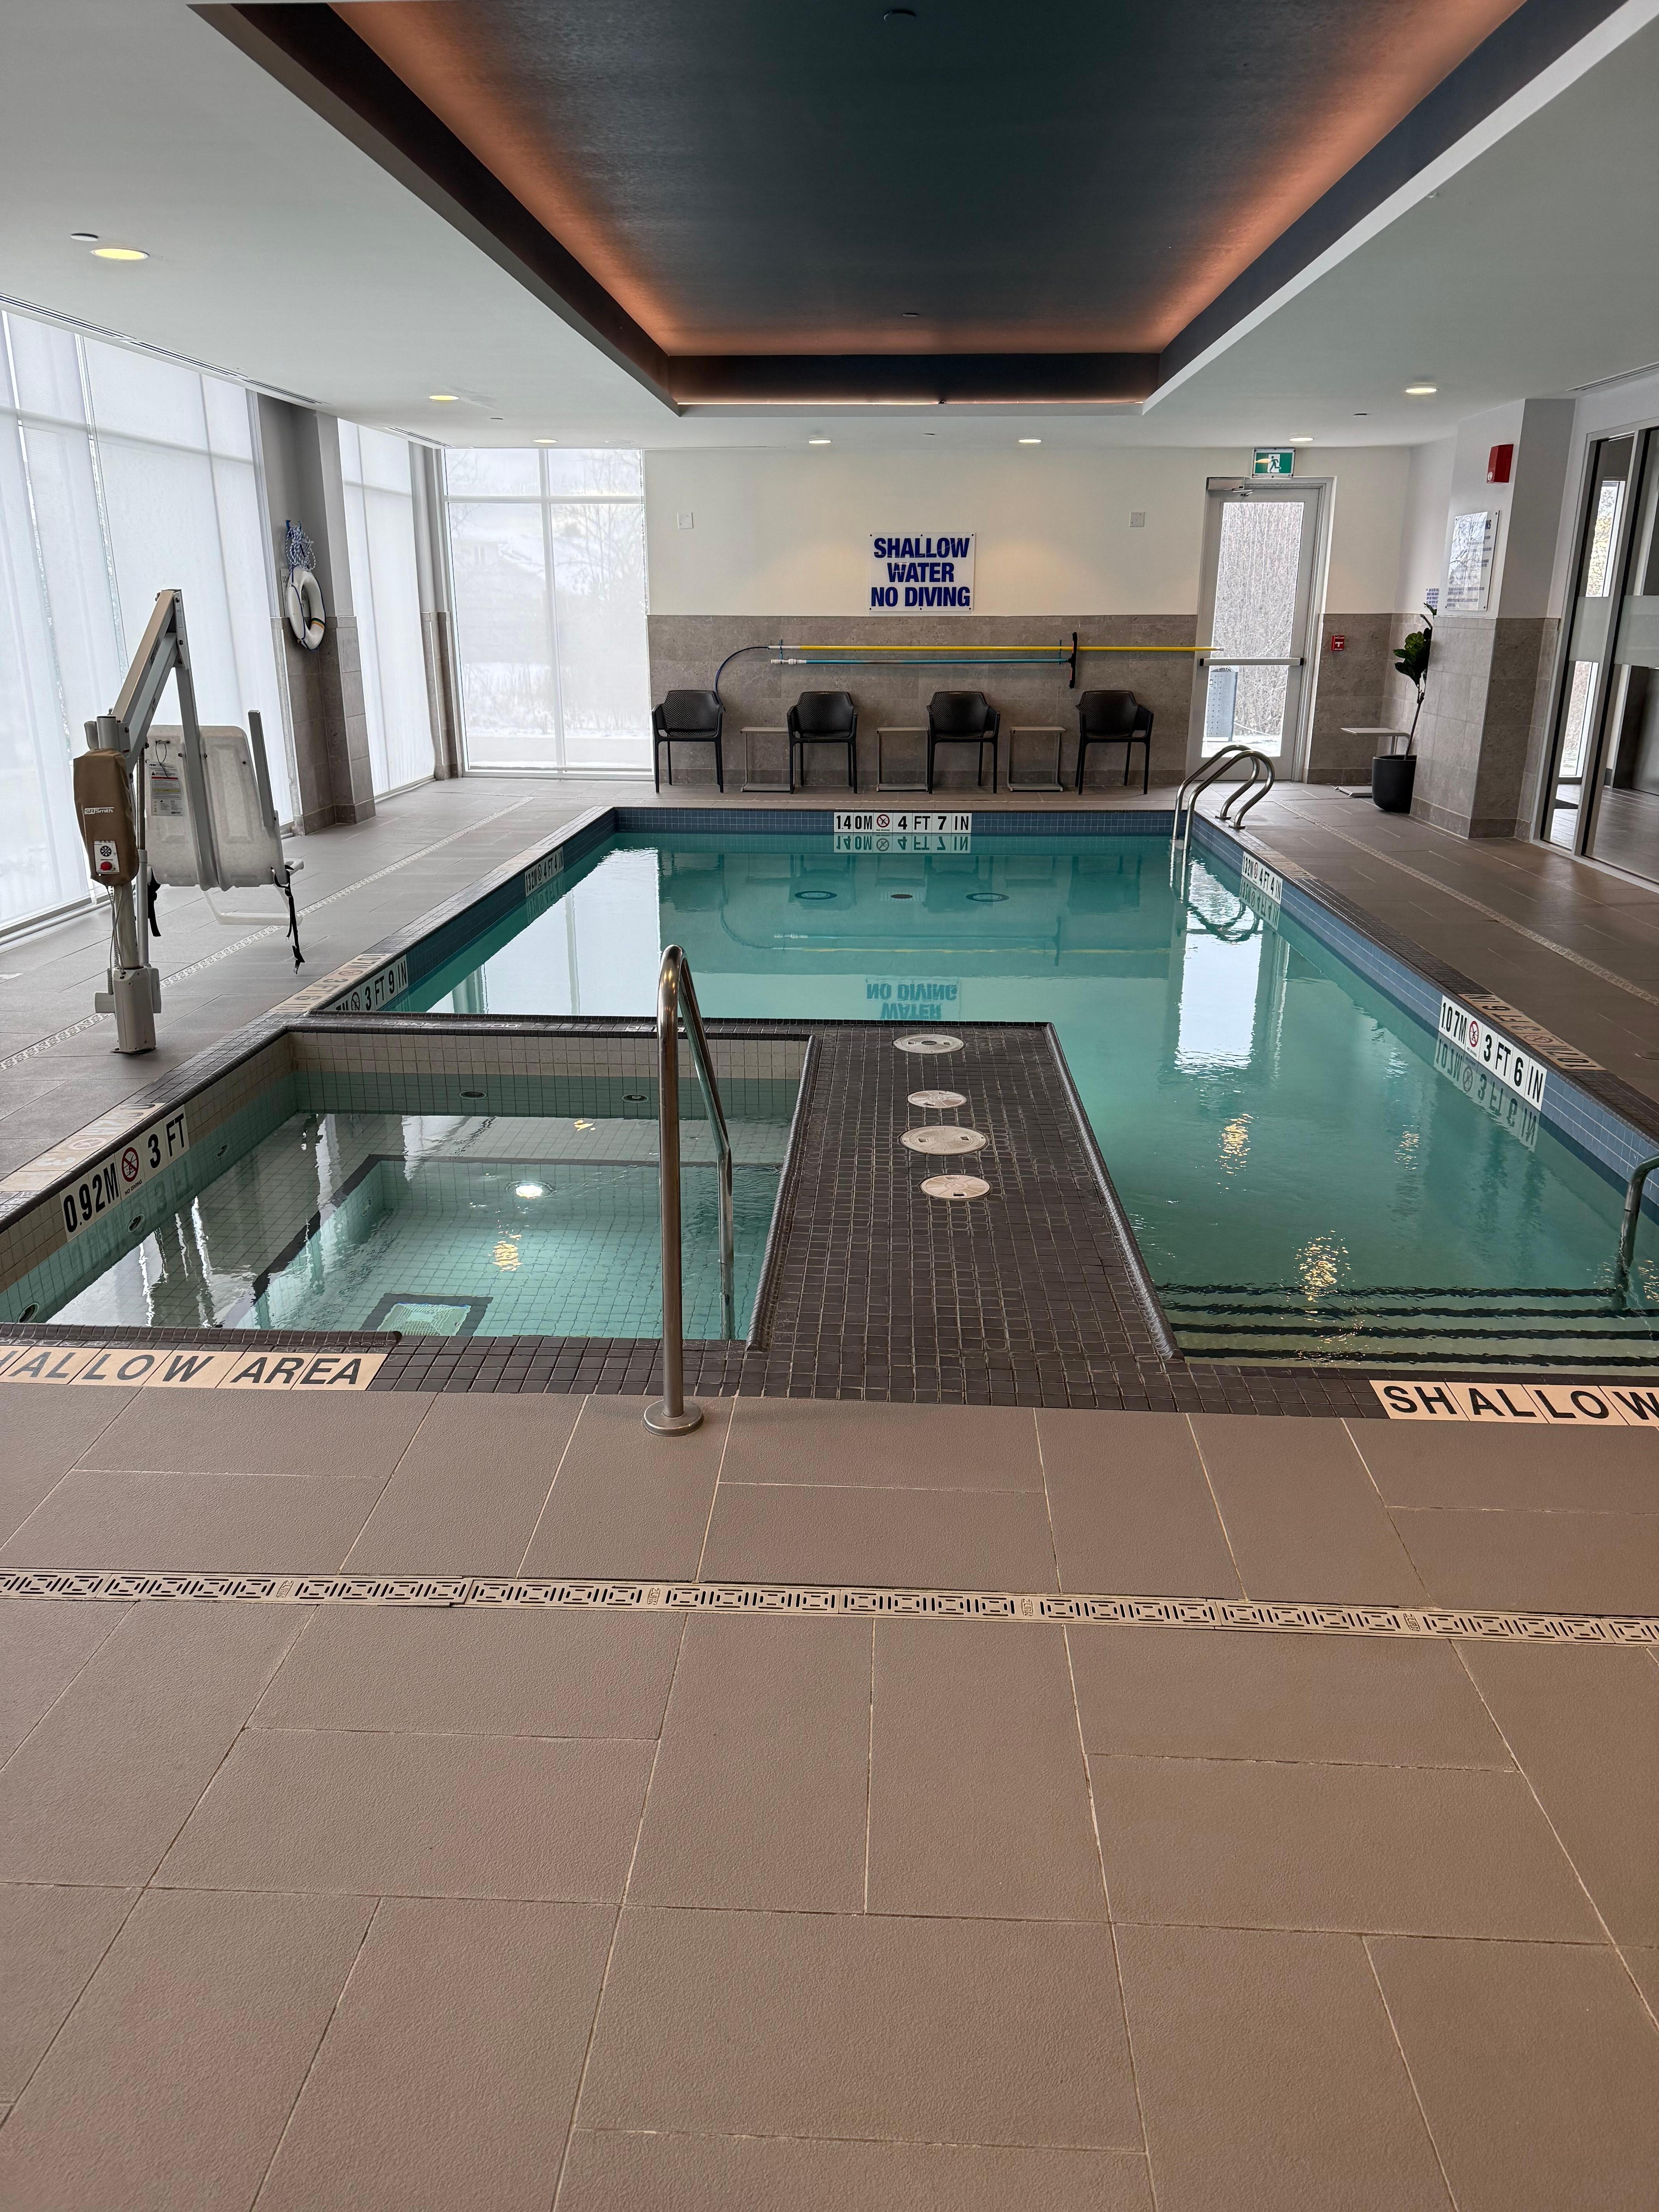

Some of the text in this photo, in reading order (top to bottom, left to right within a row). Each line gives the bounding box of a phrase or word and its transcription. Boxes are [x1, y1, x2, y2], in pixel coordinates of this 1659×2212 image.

[874, 538, 970, 558] SHALLOW
[887, 562, 955, 582] WATER
[871, 586, 970, 607] NO DIVING
[898, 816, 907, 830] 4
[914, 816, 931, 830] FT
[938, 816, 947, 830] 7
[955, 816, 969, 830] IN
[548, 857, 553, 877] FT
[1259, 868, 1263, 886] 4
[1264, 871, 1270, 891] FT
[1271, 876, 1274, 895] 4
[365, 960, 407, 1011] 3 FT 9 IN
[1491, 1013, 1531, 1023] FT
[1484, 1034, 1492, 1062] 3
[1495, 1042, 1511, 1077] FT
[1514, 1057, 1523, 1087] 6
[1527, 1066, 1544, 1103] IN
[63, 1162, 119, 1233] 0.92M
[148, 1133, 161, 1168] 3
[166, 1113, 184, 1157] FT
[229, 1357, 361, 1385] AREA
[1383, 1386, 1659, 1420] SHALLOW
